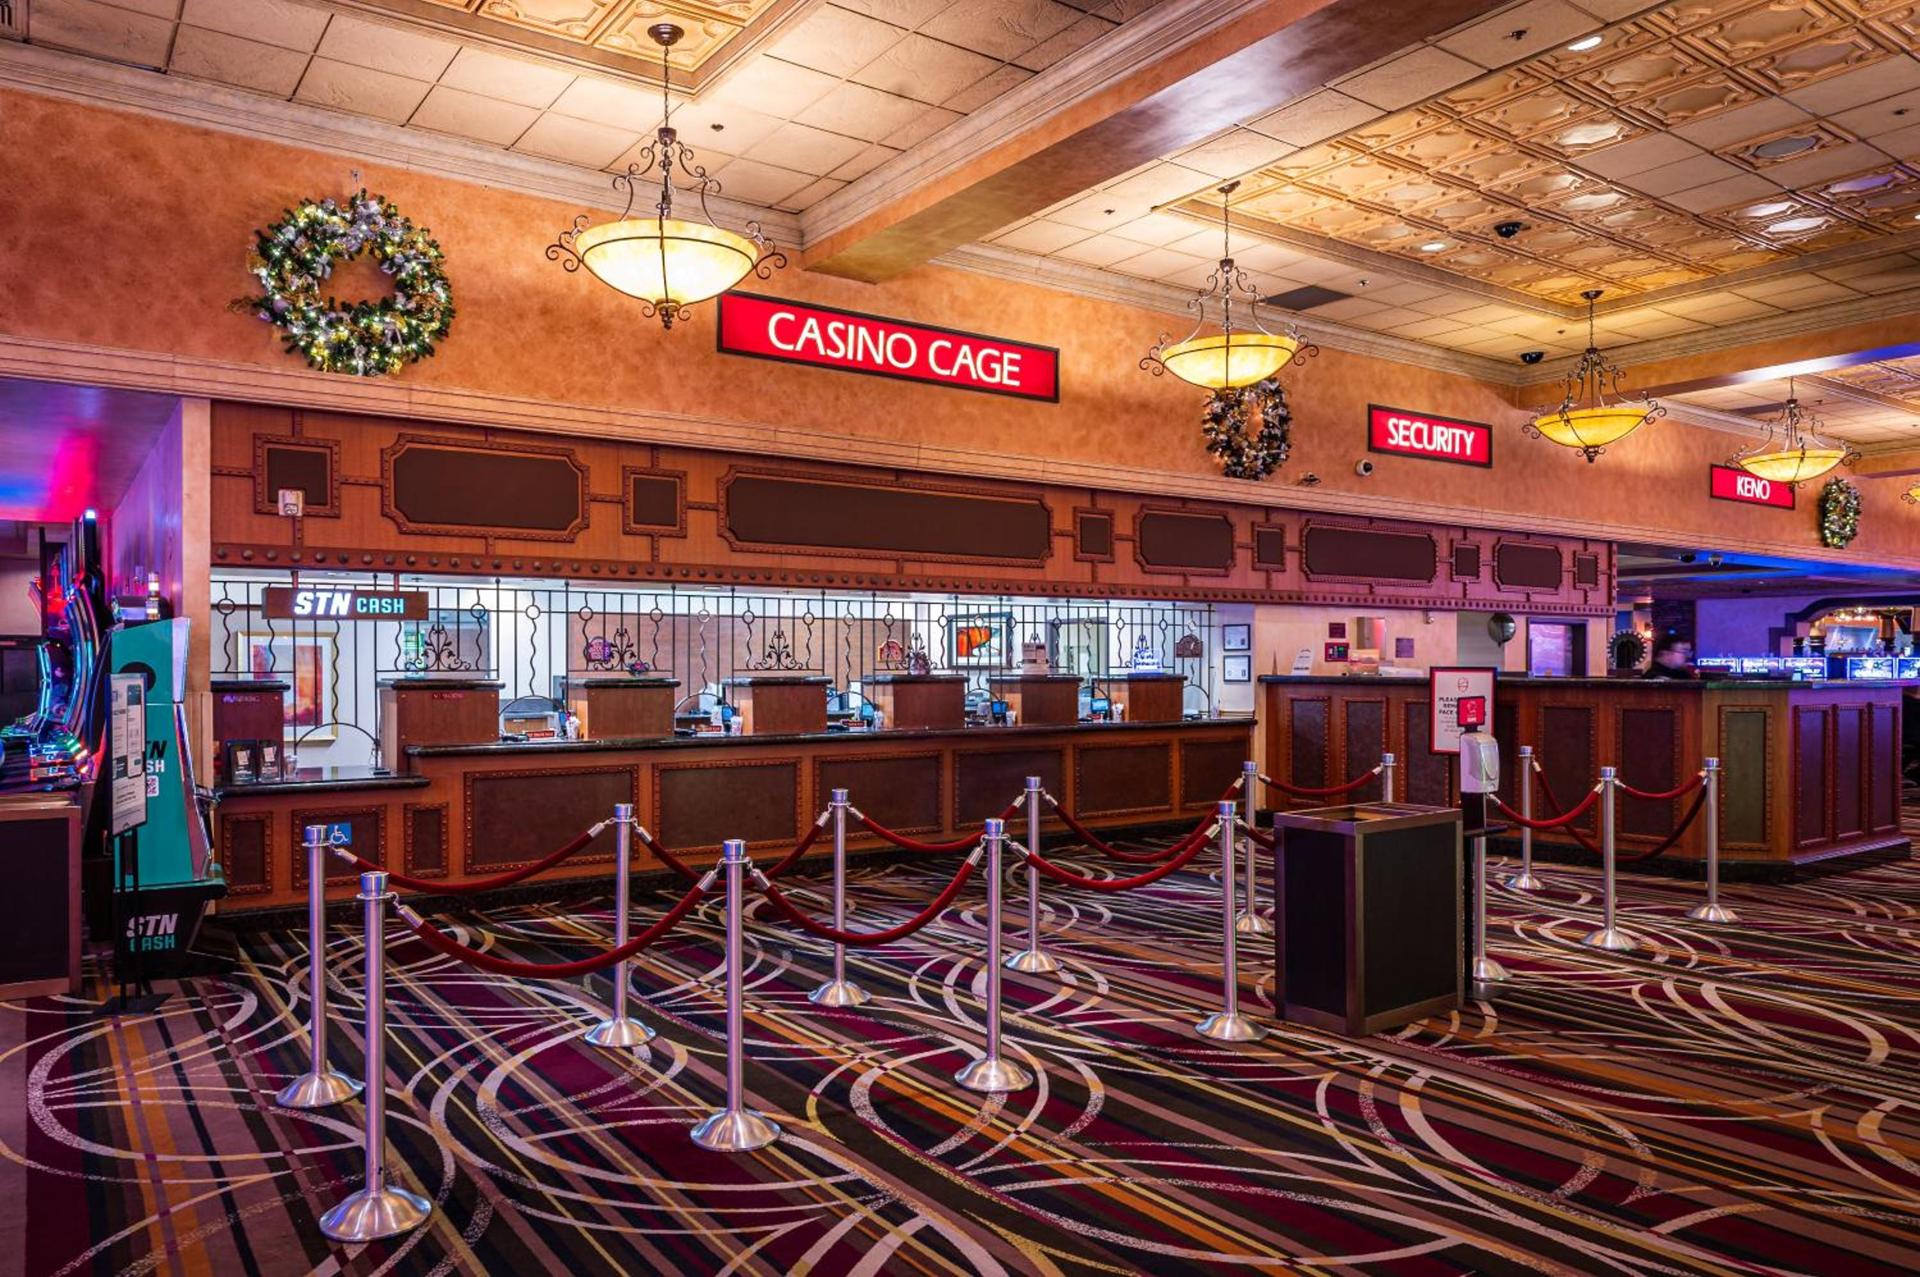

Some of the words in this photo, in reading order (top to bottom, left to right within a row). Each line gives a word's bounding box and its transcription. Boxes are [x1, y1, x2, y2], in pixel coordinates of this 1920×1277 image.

[767, 311, 918, 370] CASINO
[928, 340, 1022, 387] CAGE
[1387, 417, 1475, 457] SECURITY
[1735, 476, 1771, 500] KENO
[294, 591, 352, 616] STN
[356, 597, 405, 614] CASH
[126, 913, 179, 938] STN
